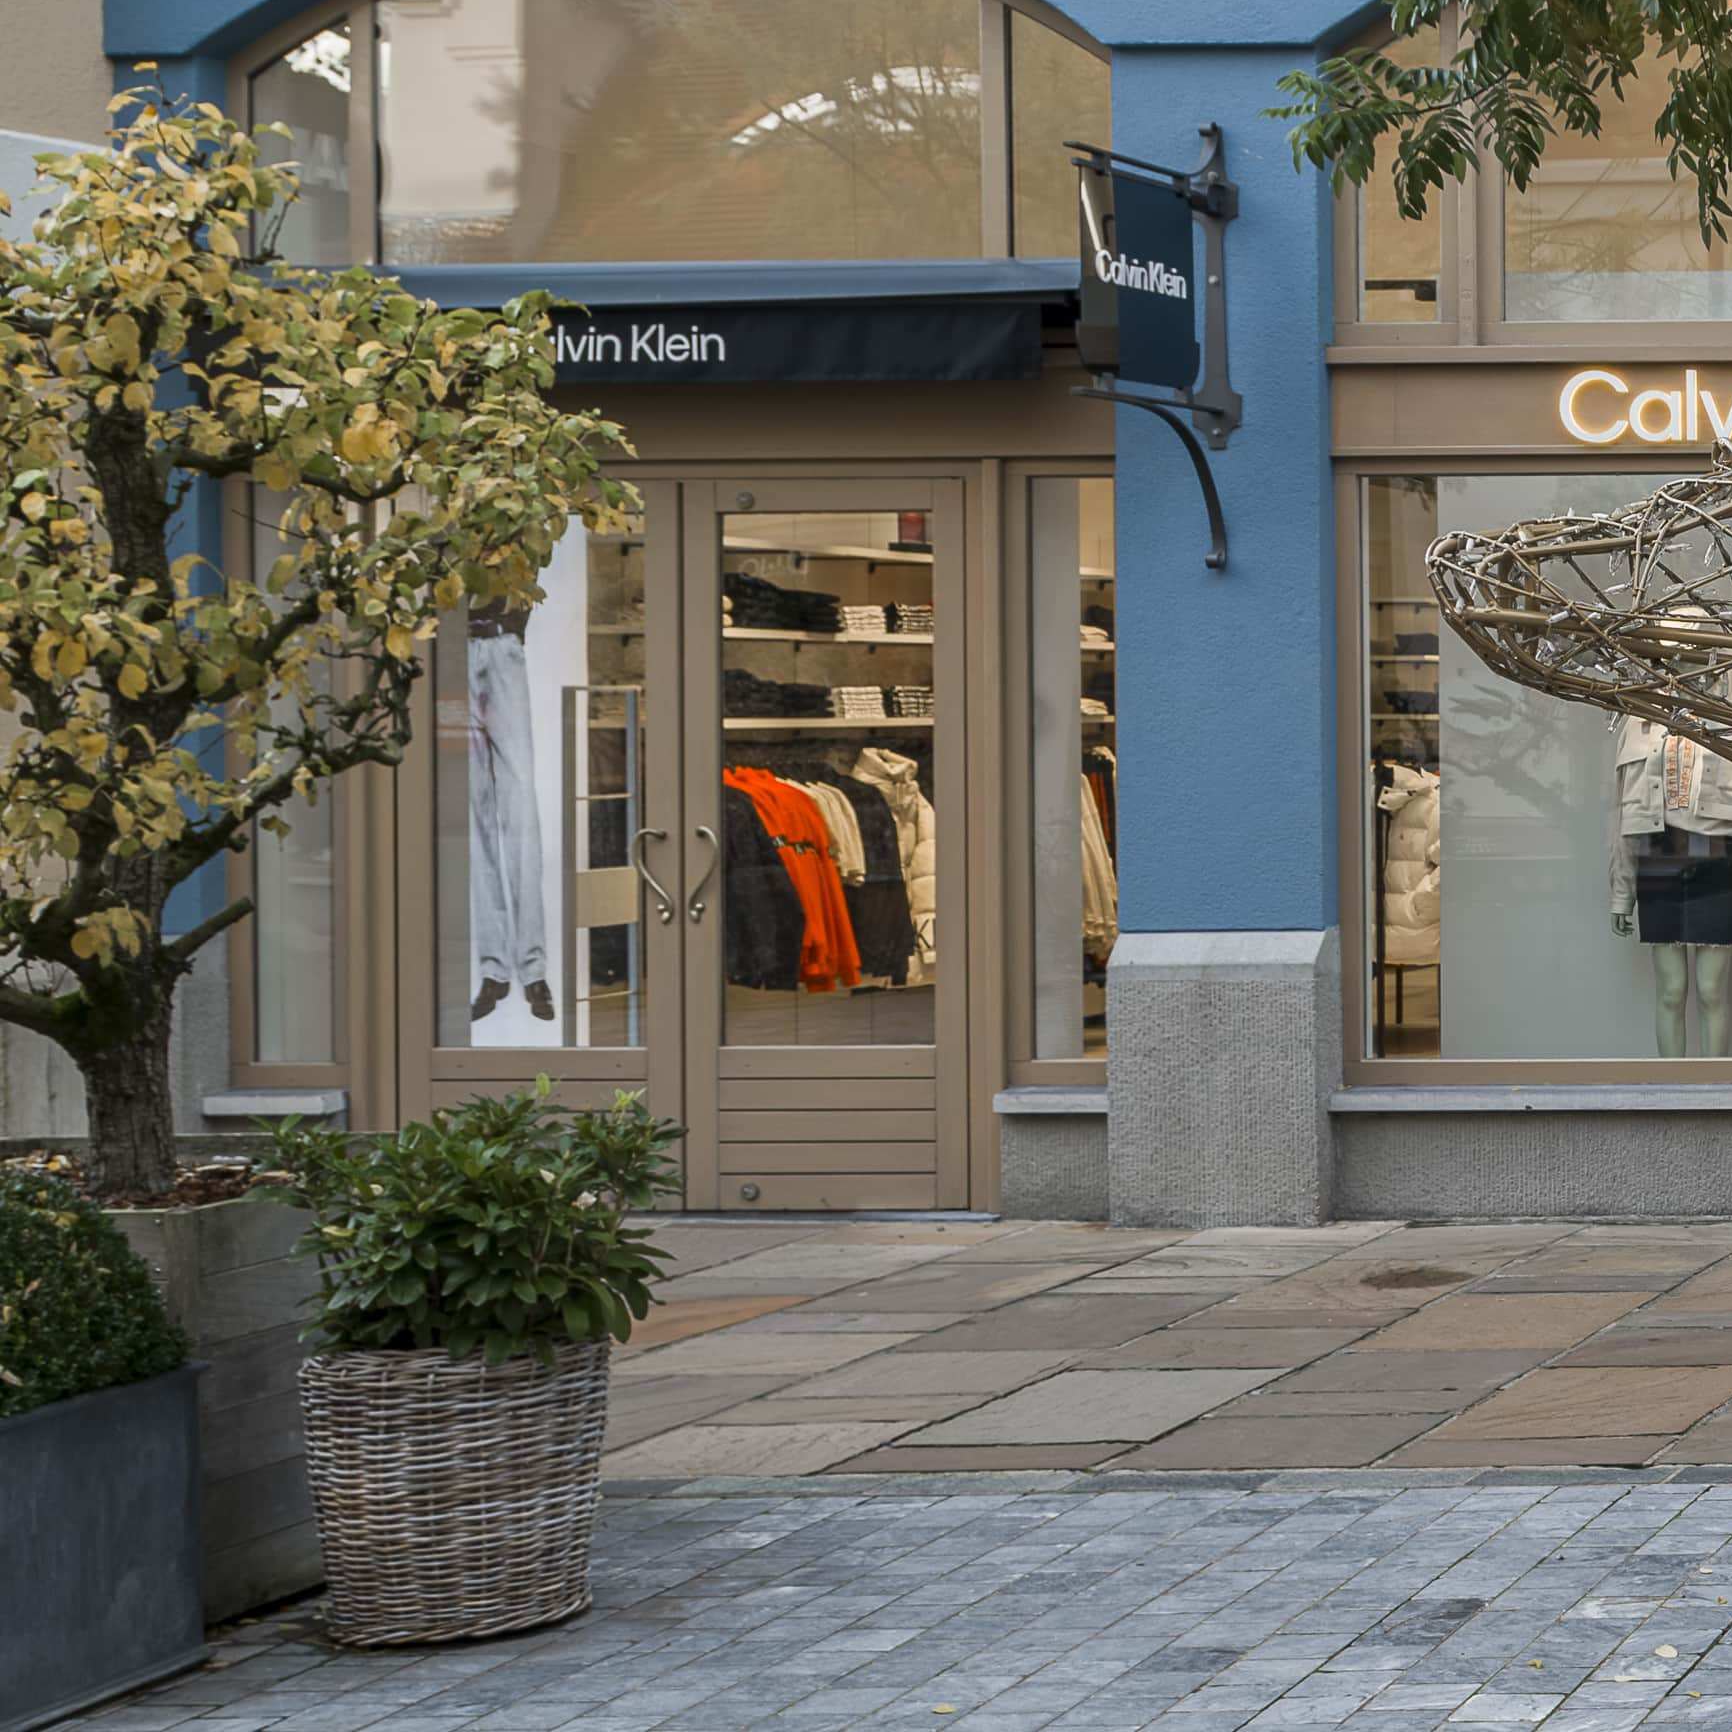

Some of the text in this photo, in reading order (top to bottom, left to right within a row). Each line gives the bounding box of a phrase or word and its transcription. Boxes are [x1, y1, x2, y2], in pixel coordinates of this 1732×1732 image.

[1095, 249, 1188, 299] Calvin Klein
[551, 323, 726, 363] lvin Klein
